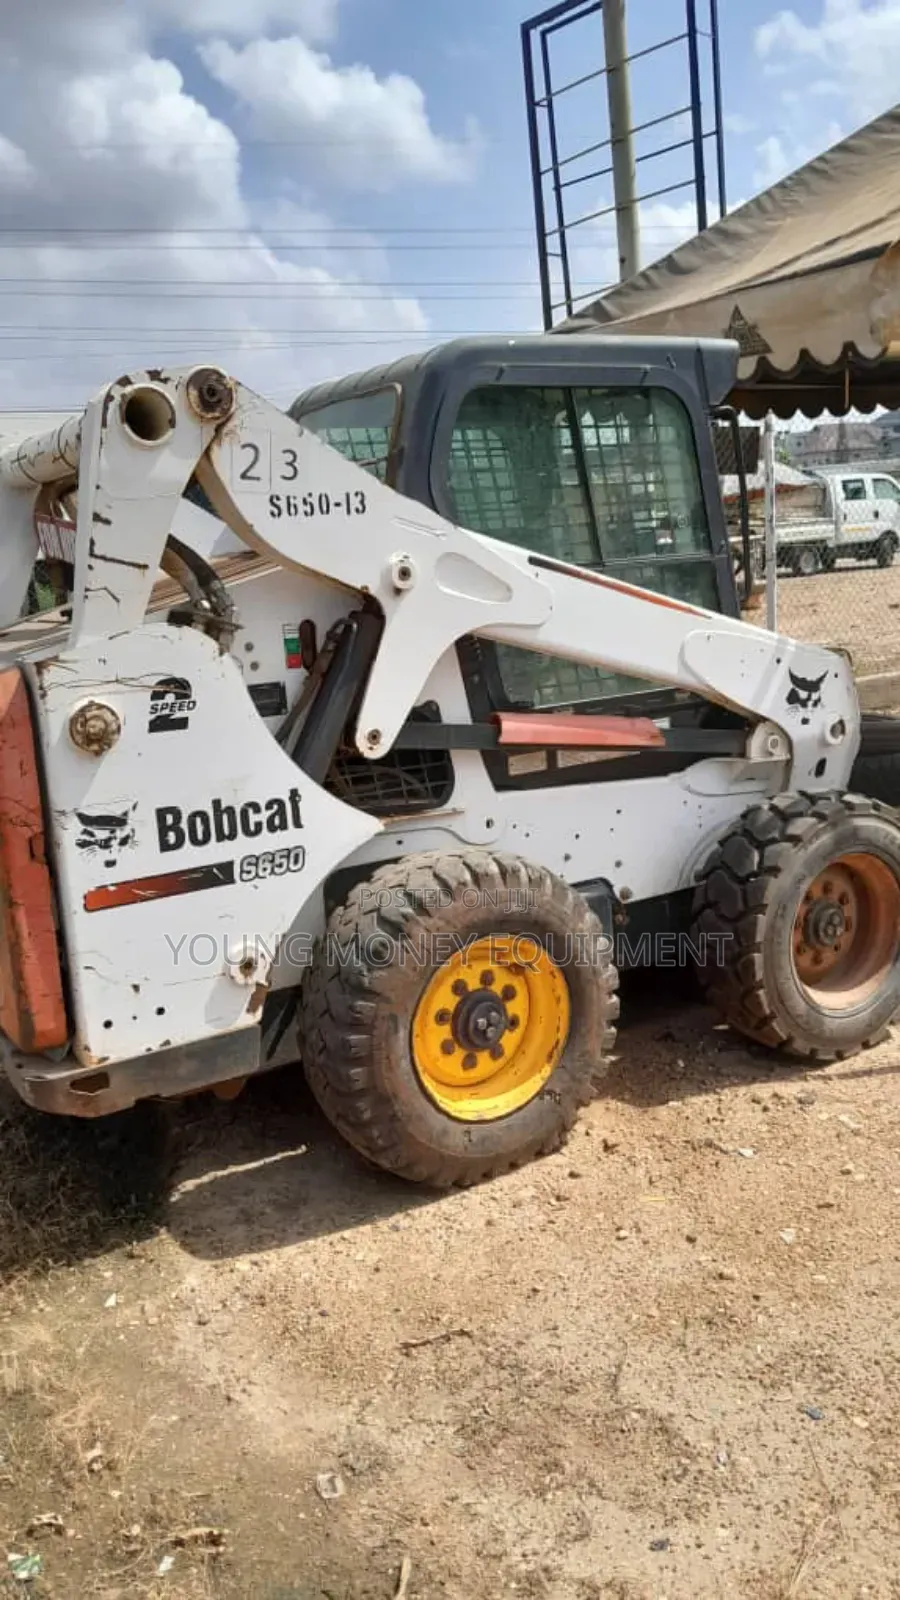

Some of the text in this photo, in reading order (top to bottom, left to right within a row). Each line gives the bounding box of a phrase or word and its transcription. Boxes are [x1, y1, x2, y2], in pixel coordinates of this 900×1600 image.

[268, 491, 367, 518] S650-13
[149, 700, 197, 714] SPEED
[155, 788, 303, 853] Bobcat
[240, 845, 305, 882] S650
